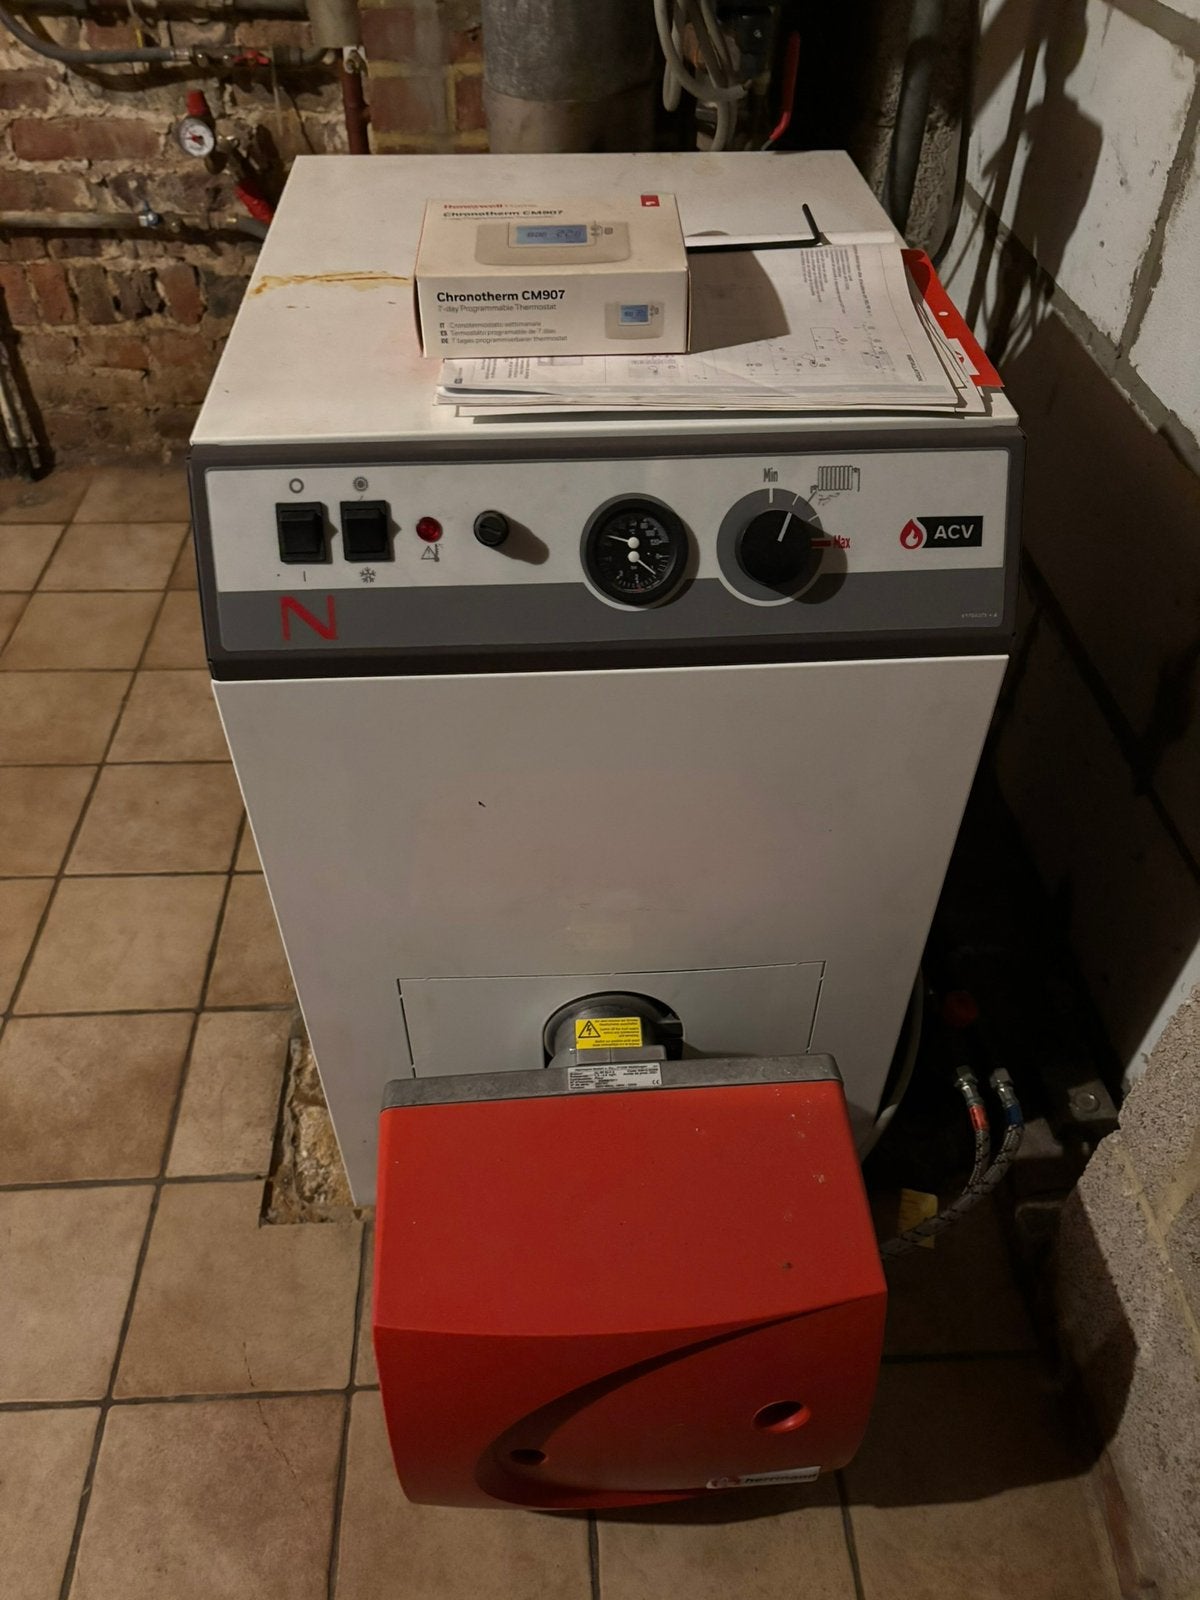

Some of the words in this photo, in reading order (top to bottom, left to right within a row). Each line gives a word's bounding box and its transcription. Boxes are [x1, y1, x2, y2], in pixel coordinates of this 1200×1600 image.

[437, 291, 519, 302] Chronotherm
[521, 289, 566, 301] CM907
[460, 304, 514, 313] Programmable
[514, 303, 557, 311] Thermostat
[763, 467, 779, 482] Min
[933, 524, 974, 540] ACV
[834, 535, 850, 549] Max
